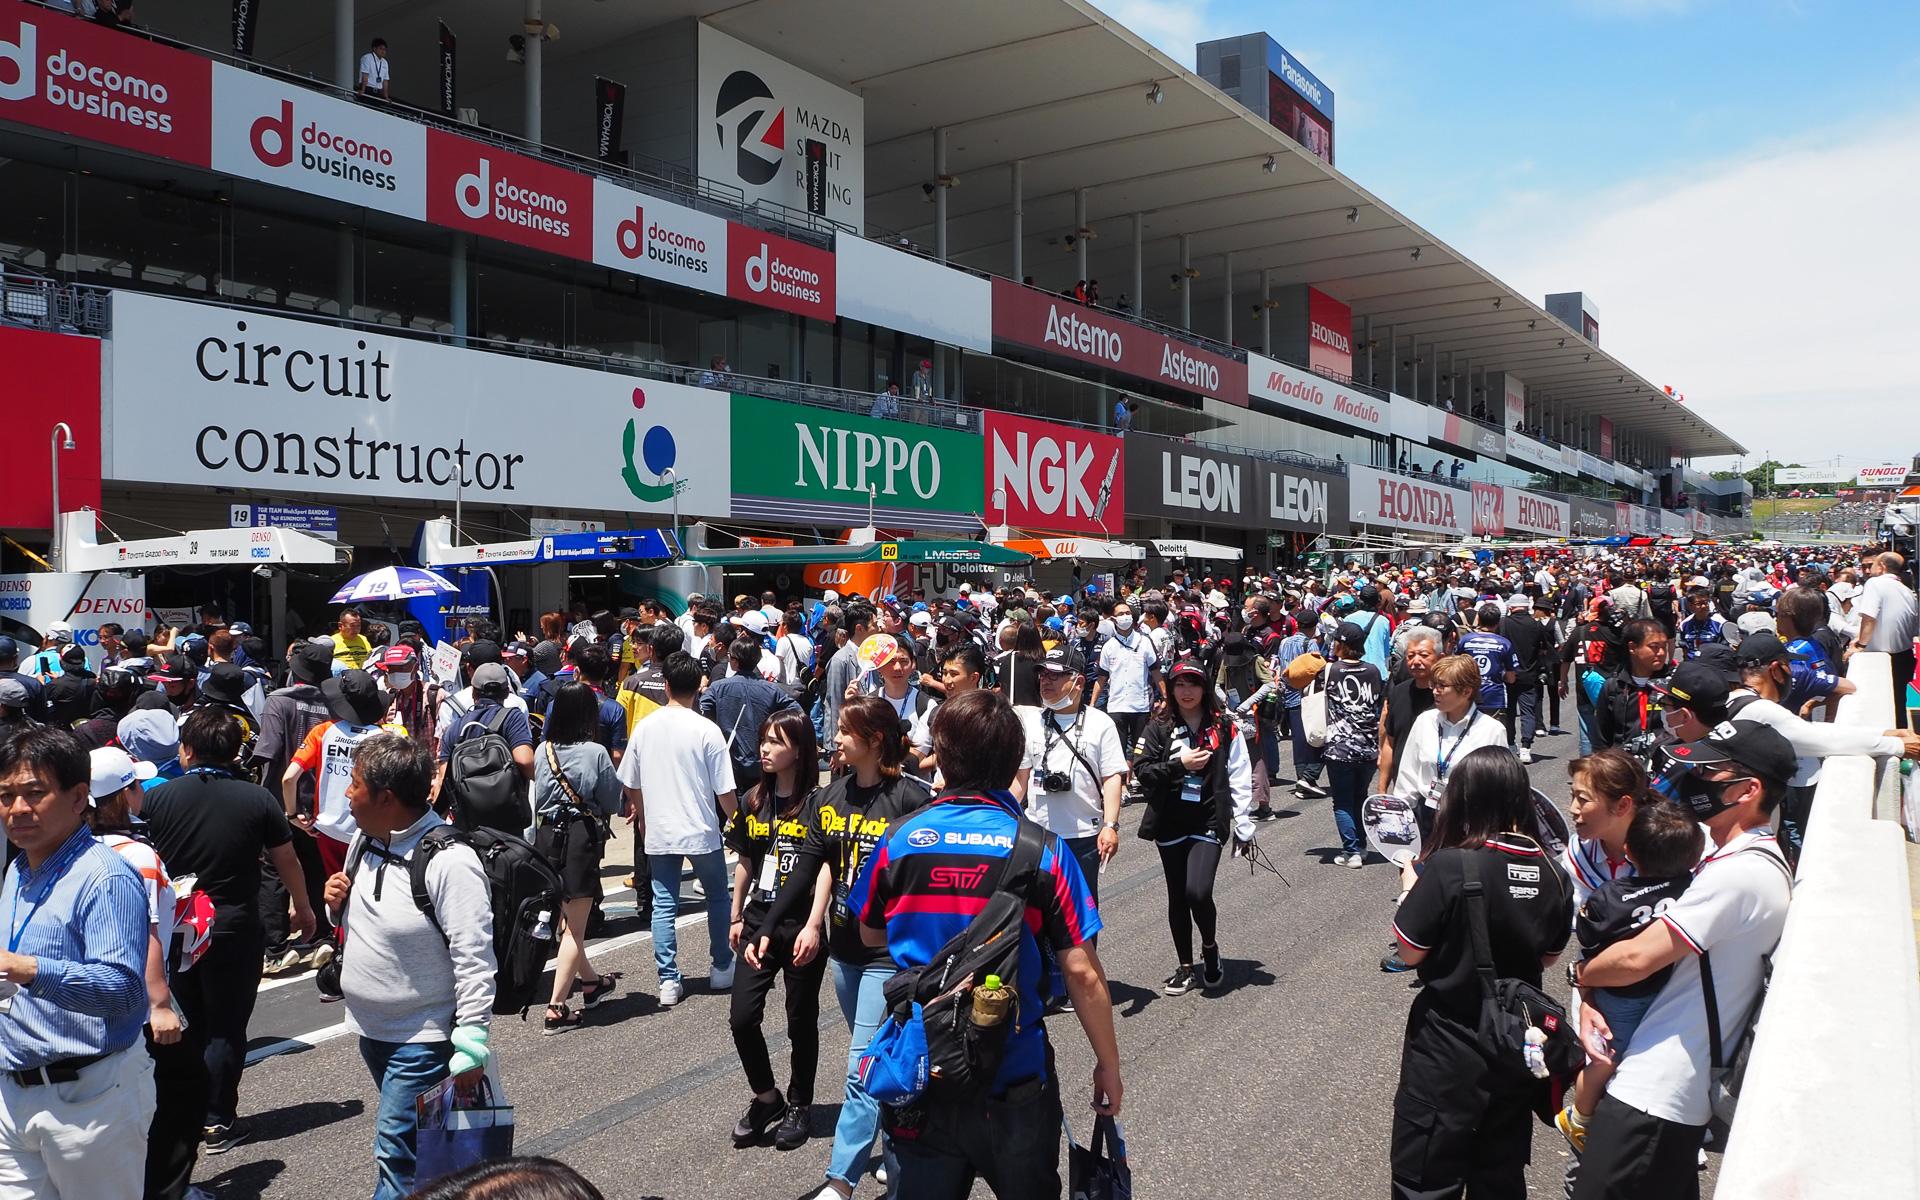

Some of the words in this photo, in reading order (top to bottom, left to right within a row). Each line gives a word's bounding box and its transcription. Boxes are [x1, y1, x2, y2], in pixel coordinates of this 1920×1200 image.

[47, 49, 168, 104] docomo
[444, 52, 453, 111] YOKOHAMA
[1281, 53, 1321, 105] Panasonic
[46, 76, 172, 133] business
[301, 122, 393, 166] docomo
[599, 103, 614, 158] YOKOHAMA
[796, 106, 851, 146] MAZDA
[301, 145, 396, 192] business
[812, 160, 820, 211] YOKOHAMA
[495, 176, 567, 215] docomo
[797, 169, 851, 206] RING
[495, 198, 570, 237] business
[648, 222, 706, 253] docomo
[648, 241, 708, 274] business
[771, 257, 819, 286] docomo
[771, 275, 821, 303] business
[1045, 304, 1122, 363] Astemo
[1160, 343, 1219, 391] Astemo
[1311, 320, 1350, 354] HONDA
[196, 321, 391, 402] circuit
[1266, 371, 1324, 406] Modulo
[1333, 393, 1379, 424] Modulo
[195, 425, 524, 490] constructor
[794, 422, 941, 499] NIPPO
[993, 427, 1095, 518] NGK
[1799, 471, 1837, 480] SoftBank
[1860, 467, 1906, 477] SUNOCO
[1162, 451, 1240, 513] LEON
[1270, 472, 1328, 524] LEON
[1378, 478, 1456, 528] HONDA
[234, 510, 248, 522] 19
[1473, 488, 1498, 531] NGK
[1518, 496, 1561, 531] HONDA
[162, 550, 178, 558] Racing
[190, 541, 198, 554] 39
[251, 547, 270, 558] KOBELCO
[252, 532, 271, 542] DENSO
[883, 547, 896, 557] 60
[1055, 542, 1079, 555] au
[925, 551, 981, 560] LMcorsa
[0, 580, 32, 592] DENSO
[368, 582, 388, 594] 19
[819, 569, 853, 584] au
[75, 599, 144, 613] DENSO
[780, 853, 800, 873] 3
